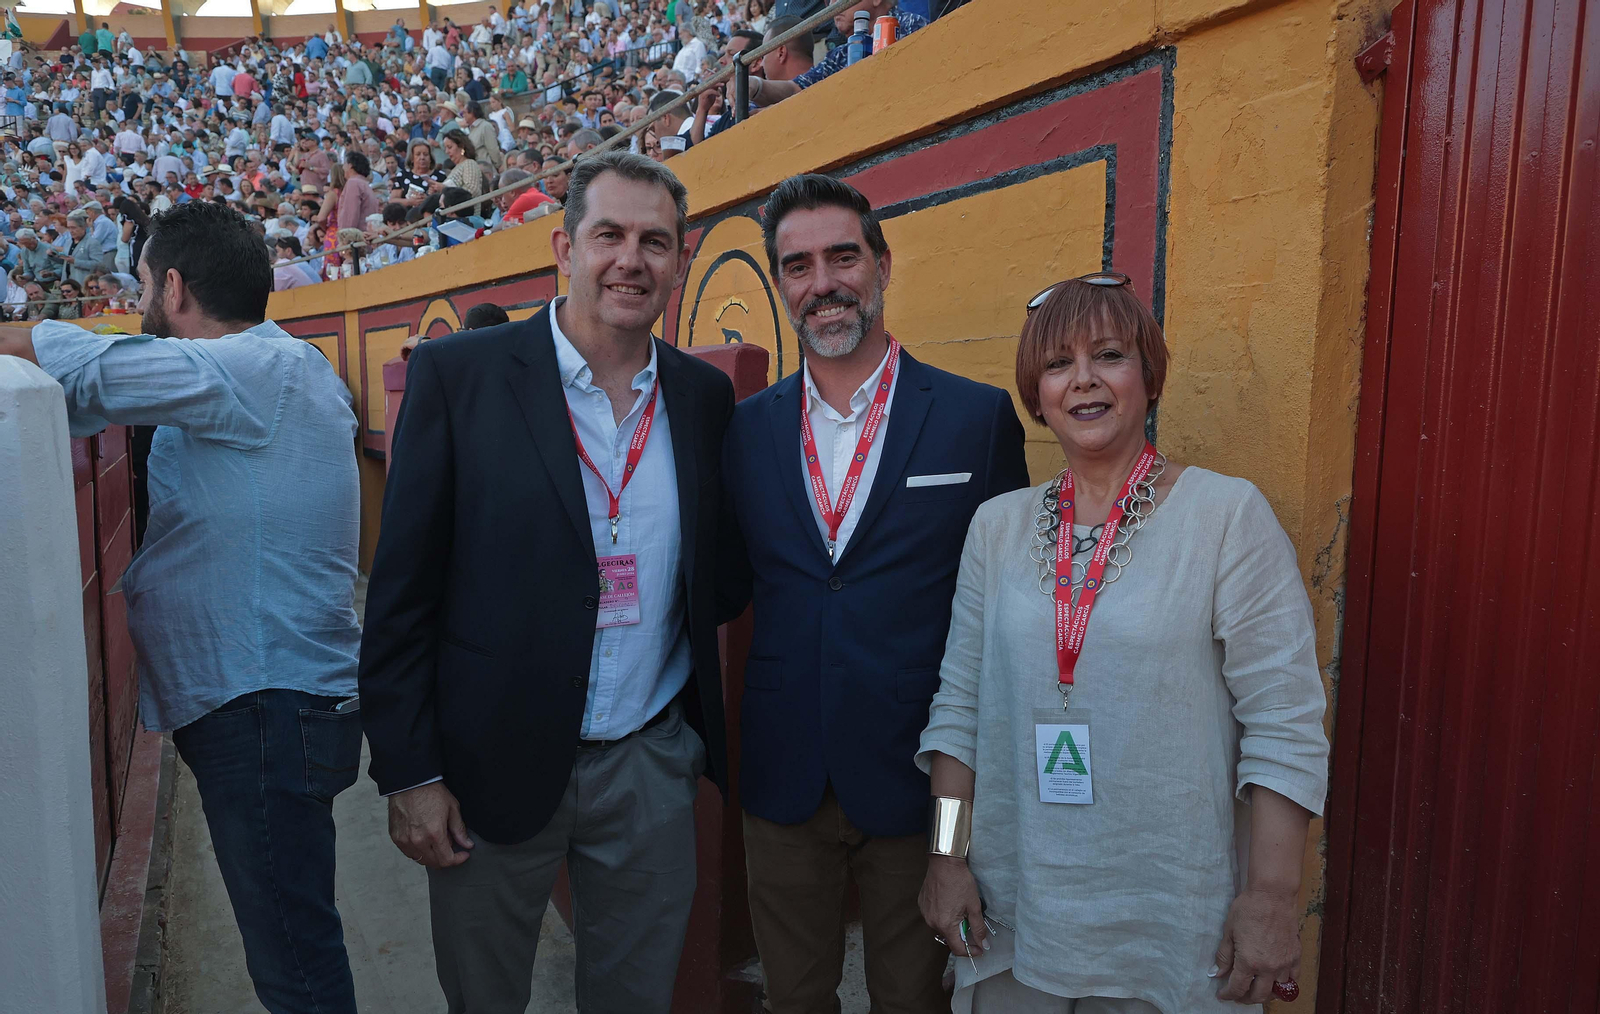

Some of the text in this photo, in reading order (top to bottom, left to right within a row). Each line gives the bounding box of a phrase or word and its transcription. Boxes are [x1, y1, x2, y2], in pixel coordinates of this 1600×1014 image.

[863, 403, 879, 438] ESPECTÁCULOS
[868, 403, 885, 442] CARMELO GARCÍA
[1127, 453, 1148, 485] ESPECTÁCULOS
[811, 475, 826, 515] CARMELO GARCÍA
[817, 476, 830, 512] ESPECTÁCULOS
[837, 476, 853, 513] ESPECTÁCULOS
[840, 475, 859, 517] CARMELO GARCÍA
[1094, 522, 1112, 562] ESPECTÁCULOS
[1099, 519, 1119, 566] CARMELO GARCÍA
[597, 559, 634, 568] LGECIRAS
[1057, 628, 1065, 651] GARCÍA
[1067, 606, 1084, 650] ESPECTÁCULOS
[1073, 604, 1091, 655] CARMELO GARCÍA
